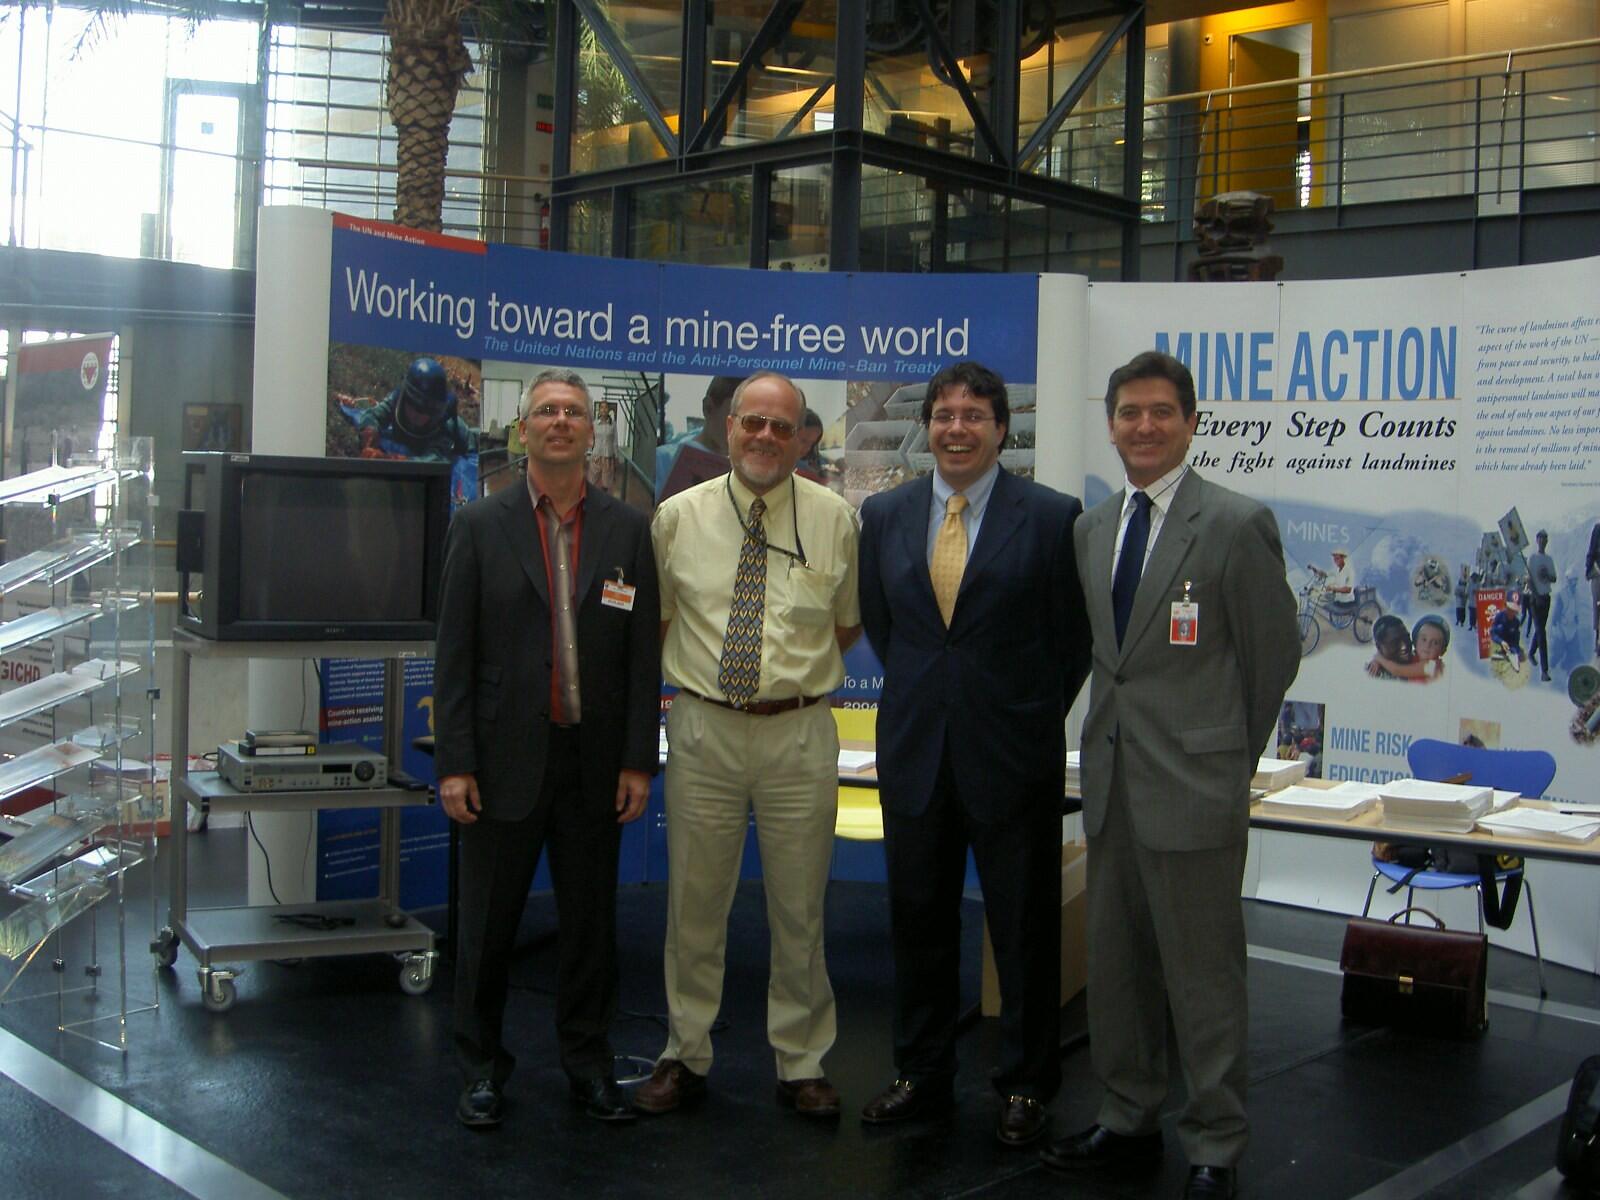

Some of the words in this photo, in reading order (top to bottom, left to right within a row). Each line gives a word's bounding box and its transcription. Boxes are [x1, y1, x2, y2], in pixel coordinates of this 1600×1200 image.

[350, 223, 360, 232] The
[362, 225, 373, 235] UN
[374, 229, 385, 238] and
[387, 231, 403, 241] Mine
[404, 234, 425, 245] Action
[346, 267, 475, 339] Working
[488, 293, 612, 341] toward
[628, 314, 650, 344] a
[666, 310, 845, 352] mine-free
[861, 318, 969, 356] world
[1520, 321, 1529, 335] of
[1530, 320, 1568, 331] landmines
[1478, 343, 1501, 354] aspect
[1504, 340, 1514, 352] of
[1515, 339, 1527, 350] the
[1529, 337, 1548, 348] work
[1550, 336, 1560, 350] of
[1560, 335, 1572, 346] the
[1575, 334, 1589, 345] UN
[484, 336, 508, 351] The
[514, 340, 561, 357] United
[565, 344, 622, 361] Nations
[627, 349, 656, 363] and
[662, 351, 685, 366] the
[690, 353, 803, 370] Anti-Personnel
[894, 360, 941, 377] Treaty
[1154, 332, 1274, 401] MINE
[1286, 325, 1457, 401] ACTION
[1476, 359, 1497, 371] from
[1498, 360, 1520, 371] peace
[1522, 355, 1539, 366] and
[1477, 375, 1494, 385] and
[1557, 371, 1576, 381] total
[1578, 370, 1592, 380] ban
[1476, 391, 1530, 405] antipersonnel
[1531, 390, 1569, 401] landmines
[1571, 387, 1586, 399] will
[1476, 409, 1489, 420] the
[1490, 409, 1506, 420] end
[1507, 408, 1517, 422] of
[1516, 408, 1533, 420] only
[1534, 410, 1548, 418] one
[1549, 408, 1571, 420] aspect
[1573, 405, 1583, 419] of
[1193, 410, 1272, 445] Every
[1286, 410, 1346, 447] Step
[1359, 410, 1457, 438] Counts
[1475, 427, 1504, 440] against
[1549, 424, 1560, 434] No
[1562, 424, 1574, 434] less
[1485, 443, 1497, 454] the
[1499, 443, 1530, 454] removal
[1530, 443, 1541, 456] of
[1541, 442, 1570, 453] millions
[1572, 441, 1583, 455] of
[1192, 451, 1220, 468] the
[1227, 451, 1274, 473] fight
[1286, 452, 1352, 474] against
[1362, 452, 1456, 472] landmines
[1475, 460, 1499, 471] which
[1501, 460, 1519, 471] have
[1520, 460, 1547, 474] already
[1549, 459, 1567, 471] been
[1287, 519, 1350, 543] MINES
[1478, 591, 1504, 601] DANGER
[860, 679, 868, 688] a
[327, 708, 355, 717] Countries
[356, 705, 384, 714] receiving
[1331, 727, 1370, 753] MINE
[1375, 731, 1412, 757] RISK
[1329, 764, 1411, 785] EDUCATI
